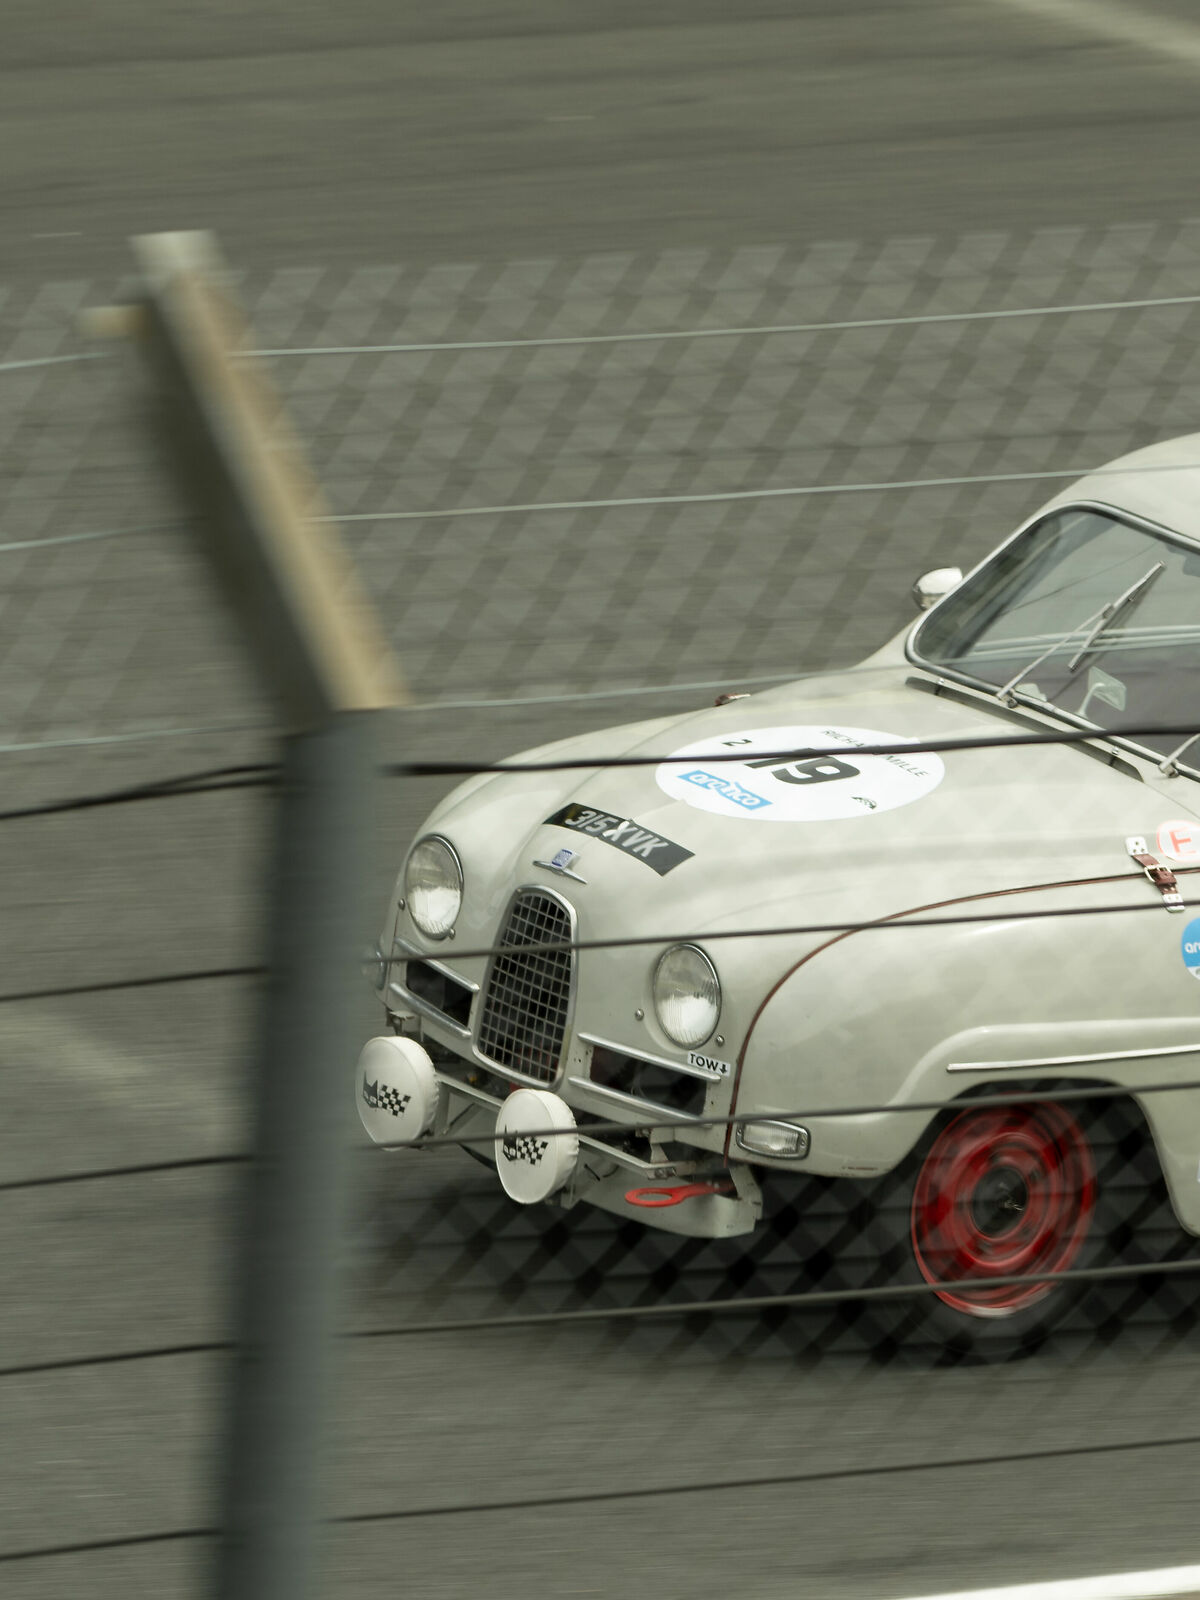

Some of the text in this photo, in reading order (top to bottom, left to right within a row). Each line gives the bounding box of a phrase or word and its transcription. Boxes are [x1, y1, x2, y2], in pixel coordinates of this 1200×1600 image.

[721, 738, 753, 747] 2
[885, 754, 929, 777] MILLE
[690, 1053, 719, 1071] TOW
